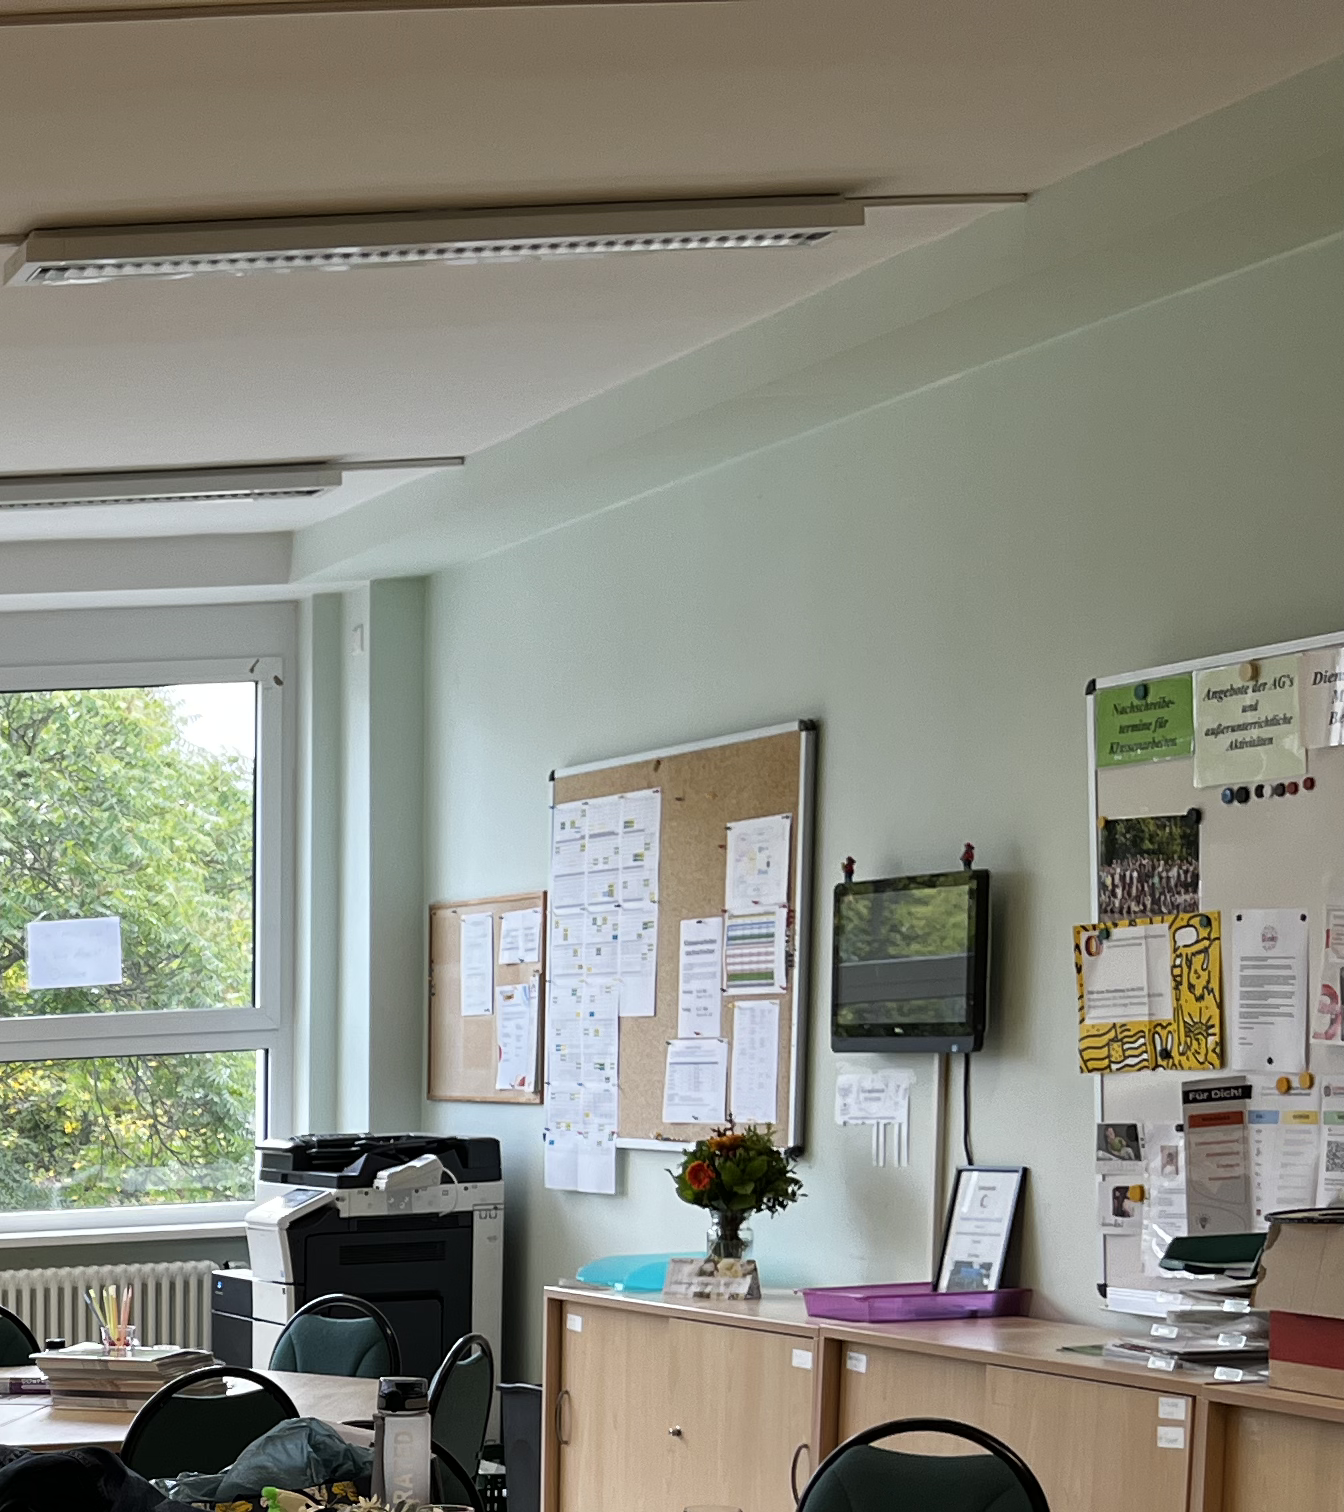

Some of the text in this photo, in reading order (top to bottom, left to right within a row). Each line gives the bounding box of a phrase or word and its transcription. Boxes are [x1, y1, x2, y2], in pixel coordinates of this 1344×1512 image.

[1203, 684, 1250, 703] Angebote
[1252, 679, 1268, 693] der
[1241, 699, 1260, 714] und
[1118, 716, 1169, 735] termine für
[1188, 1087, 1243, 1101] Für Dich!
